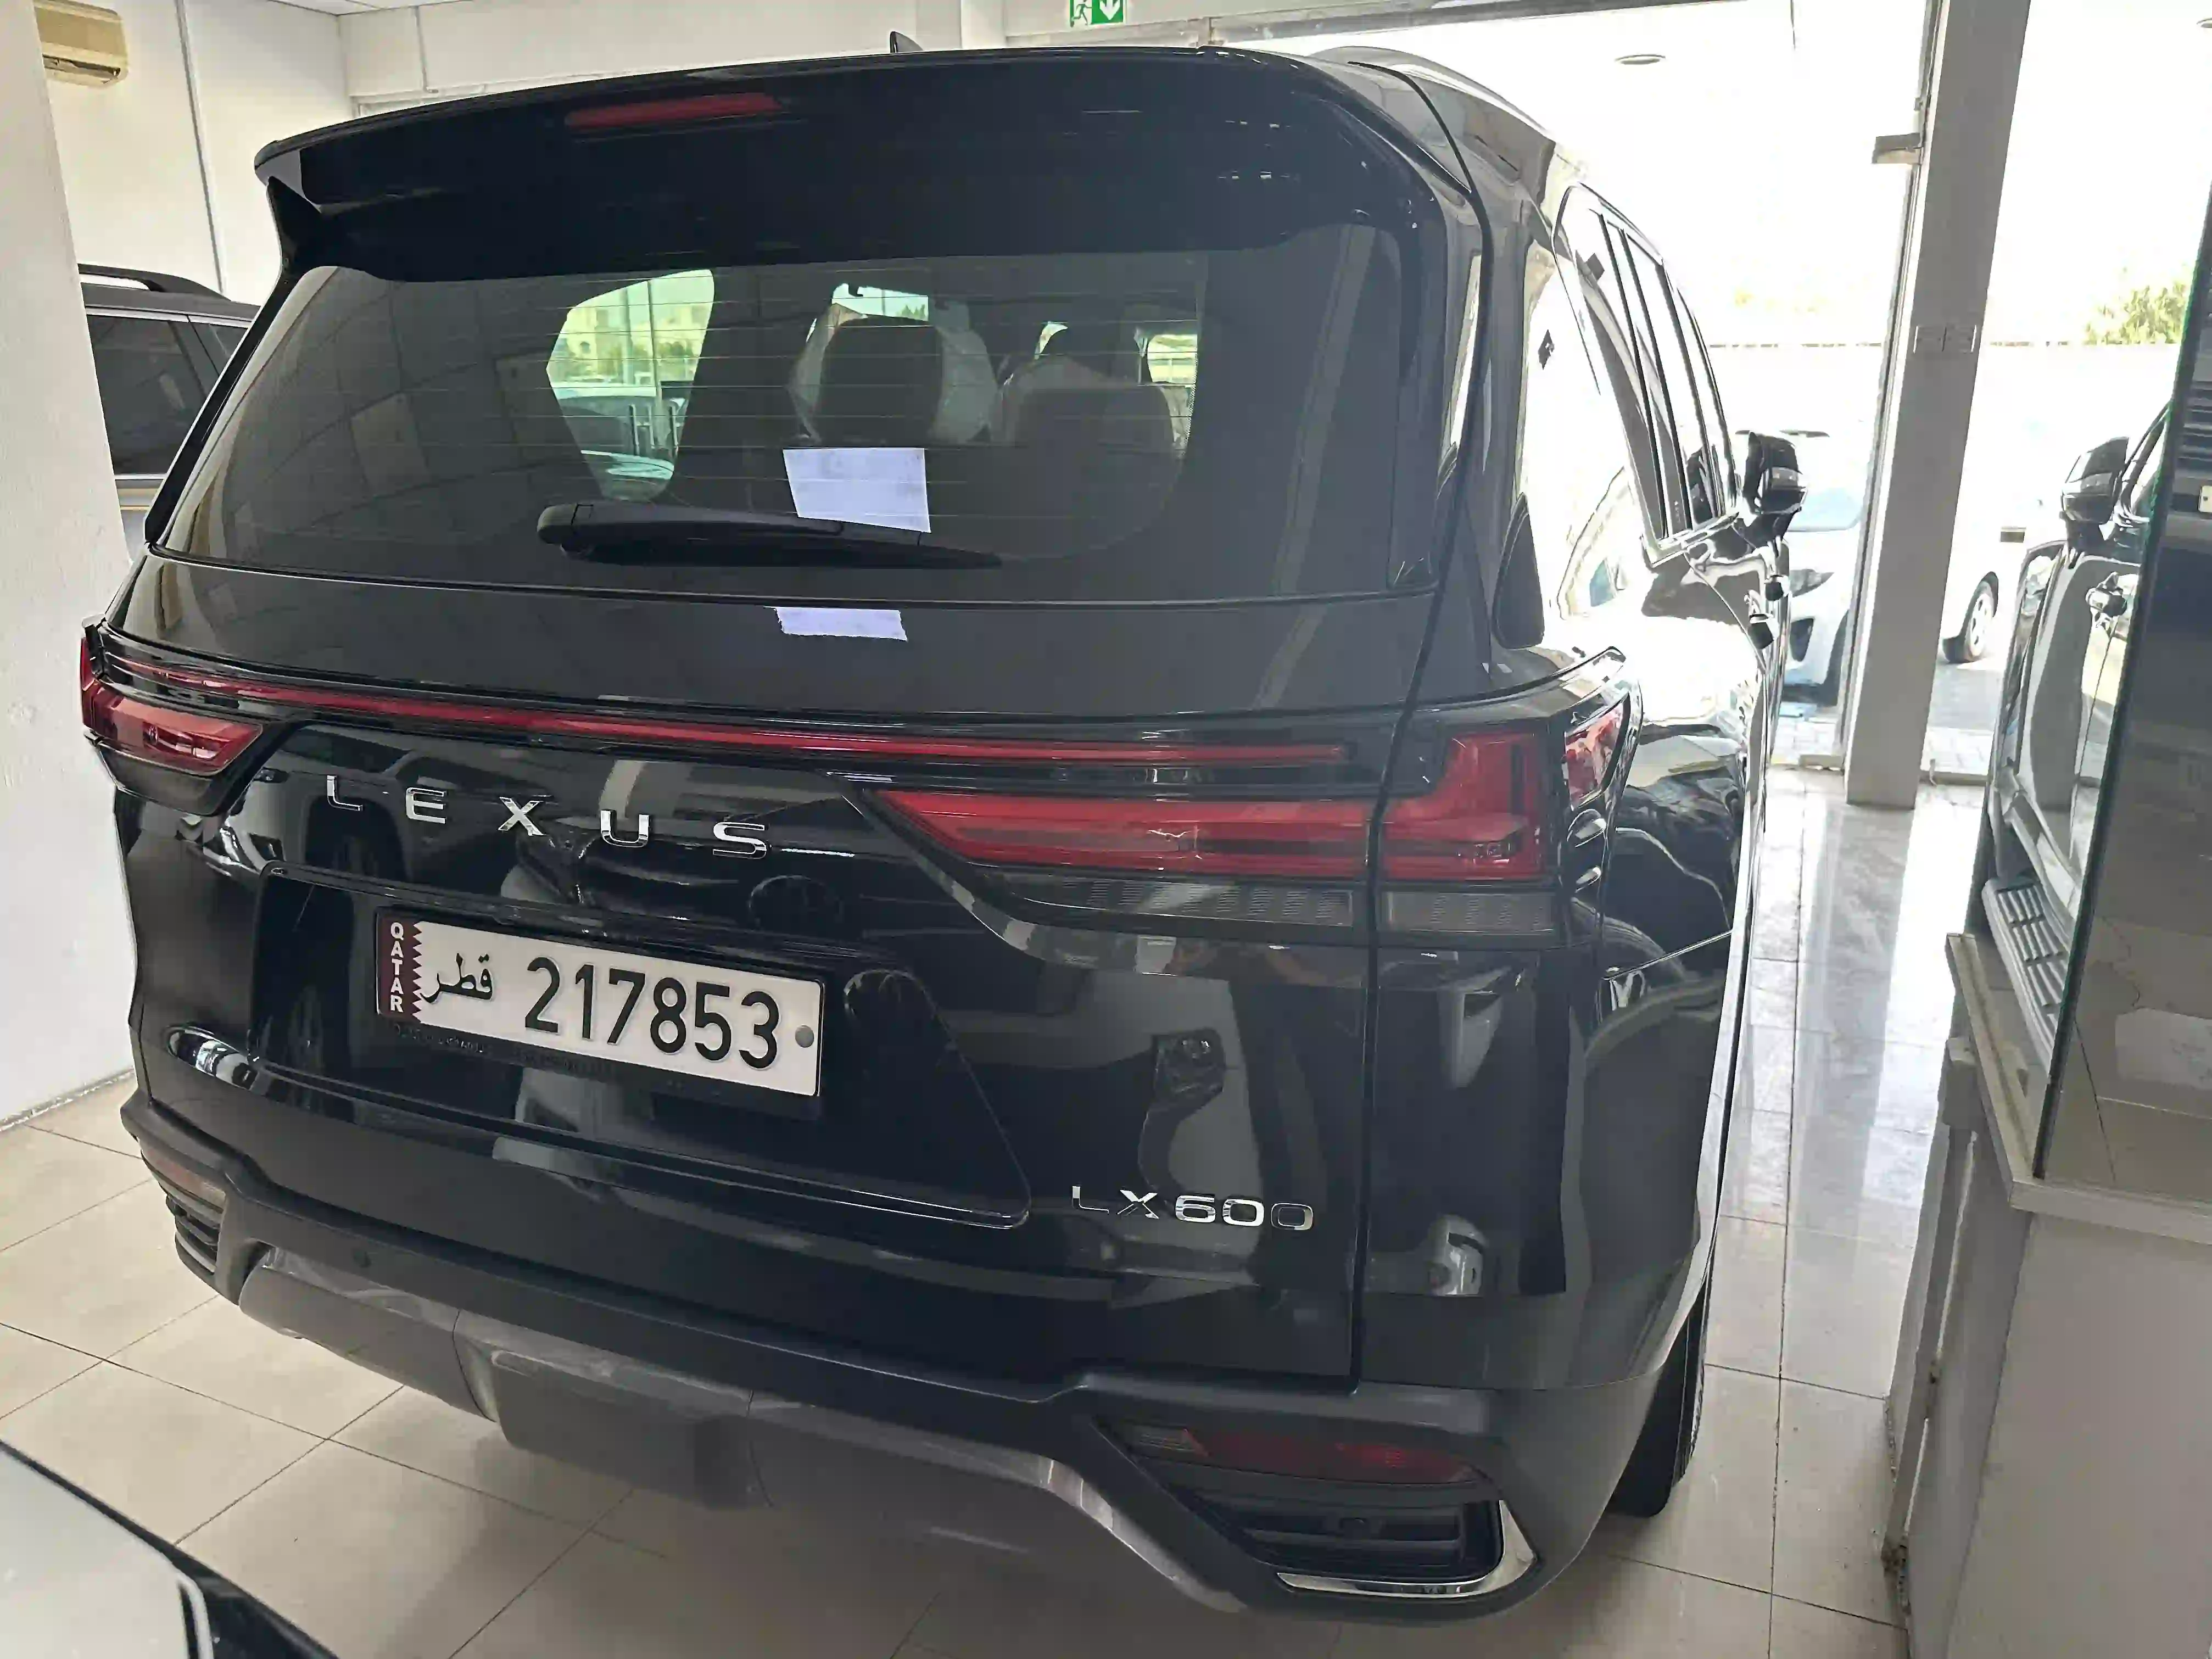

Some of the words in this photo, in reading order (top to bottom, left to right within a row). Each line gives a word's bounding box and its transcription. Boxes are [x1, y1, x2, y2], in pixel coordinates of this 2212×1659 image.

[326, 774, 767, 859] LEXUS
[389, 921, 404, 1013] QATAR
[422, 952, 494, 1003] قطر
[524, 957, 780, 1070] 217853
